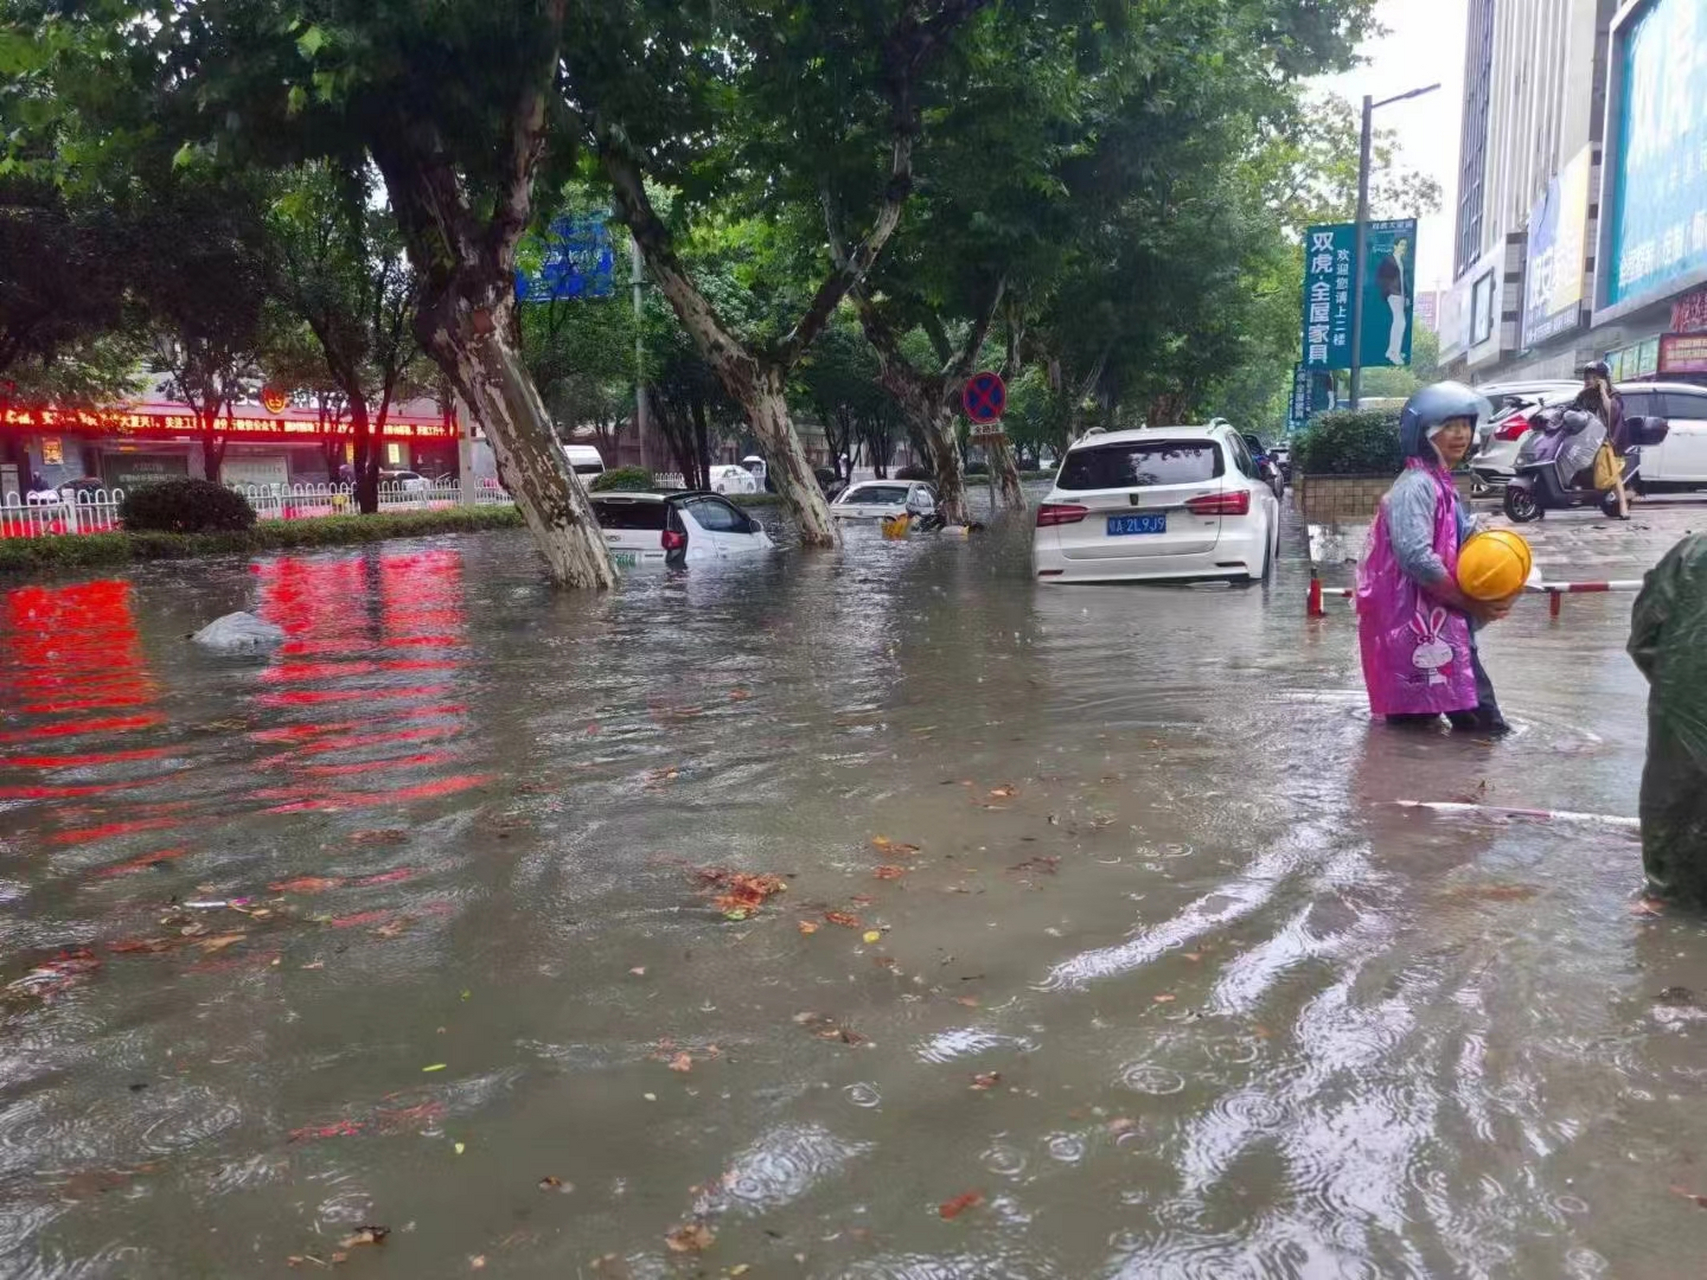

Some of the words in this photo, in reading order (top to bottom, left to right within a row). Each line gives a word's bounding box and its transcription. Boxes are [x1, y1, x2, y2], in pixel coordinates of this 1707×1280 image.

[1308, 231, 1334, 365] 双虎·全屋家具
[1333, 249, 1350, 347] 欢迎您请上二楼
